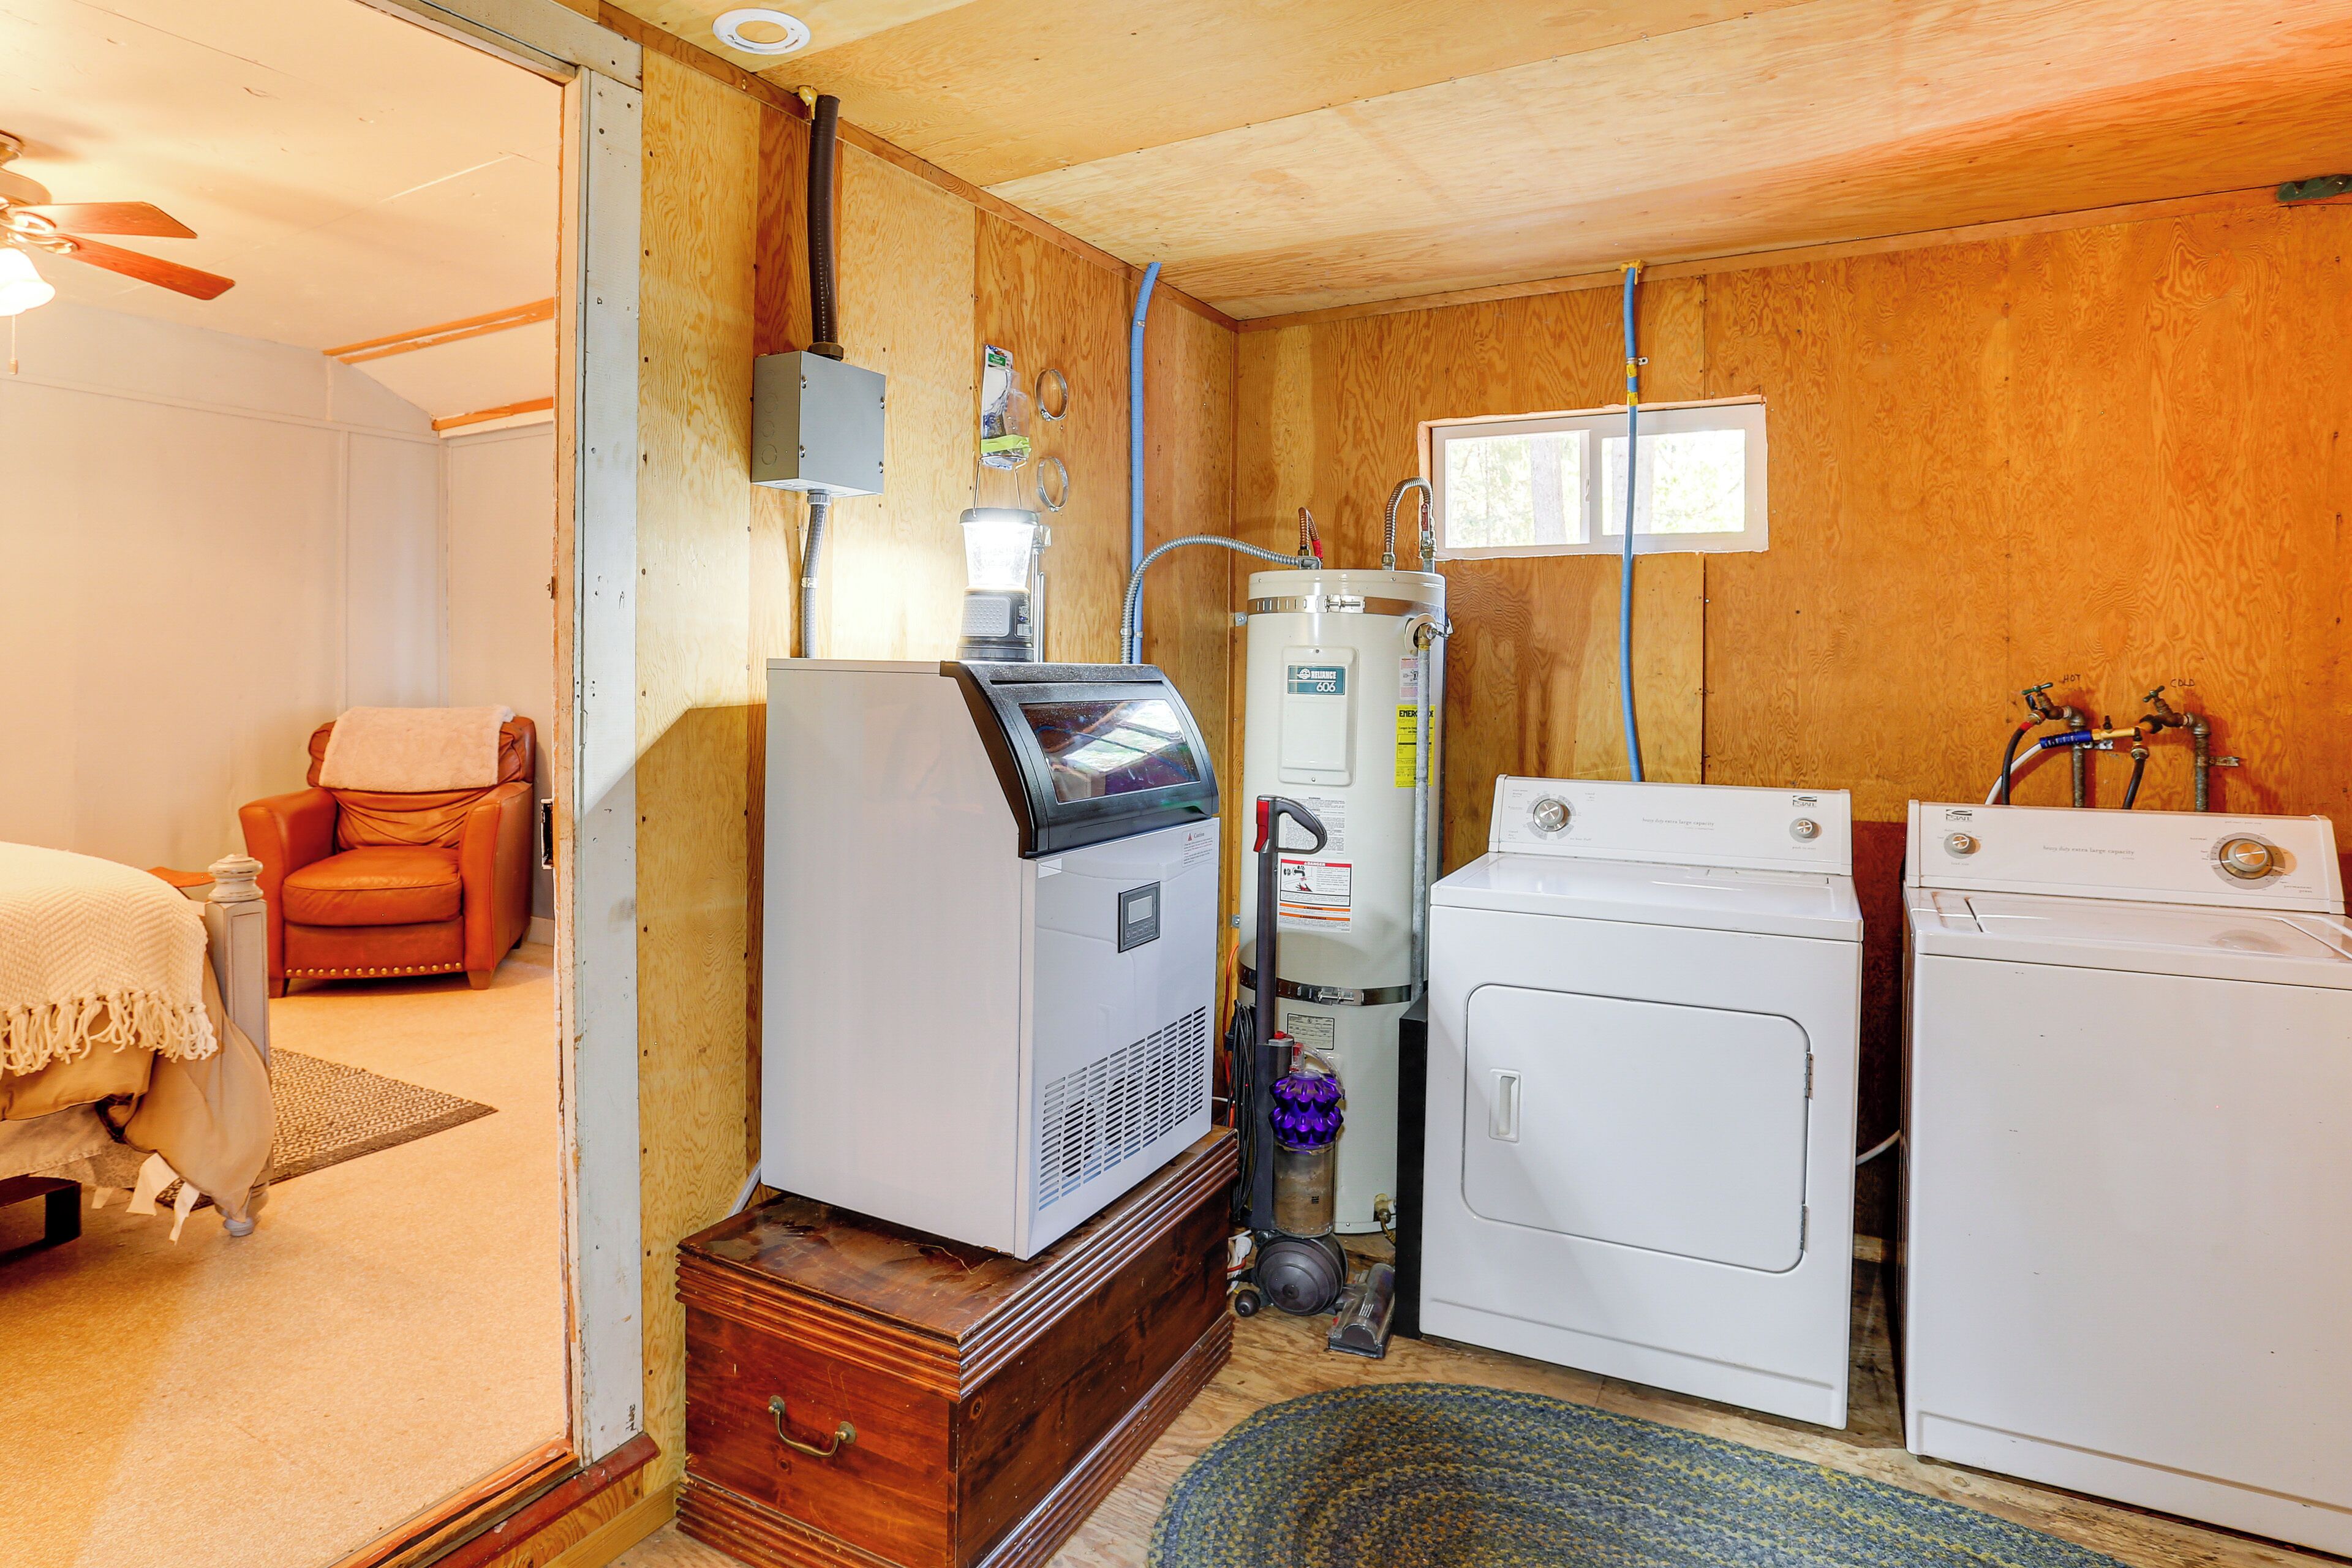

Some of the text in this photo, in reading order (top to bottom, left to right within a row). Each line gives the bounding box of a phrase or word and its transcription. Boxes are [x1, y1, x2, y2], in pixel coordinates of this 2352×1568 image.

[1311, 671, 1336, 679] RELIANCE
[2062, 674, 2081, 682] HOT
[1316, 682, 1336, 692] 606
[2170, 679, 2195, 688] COLD
